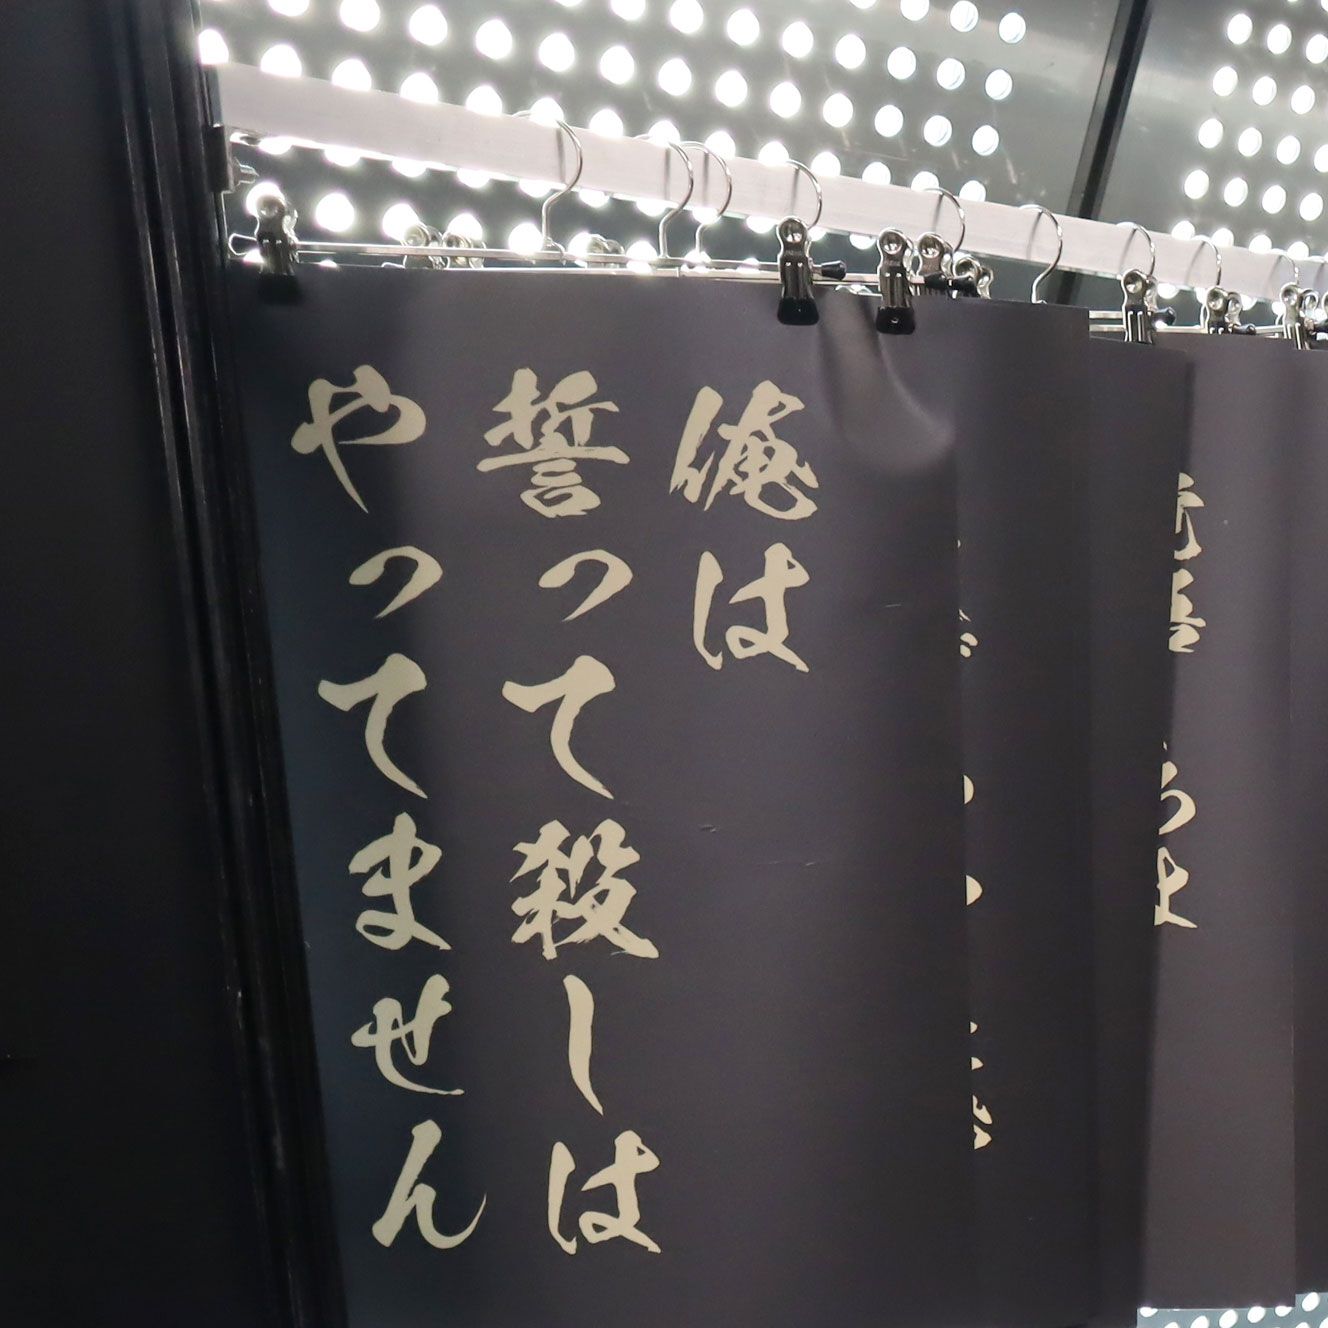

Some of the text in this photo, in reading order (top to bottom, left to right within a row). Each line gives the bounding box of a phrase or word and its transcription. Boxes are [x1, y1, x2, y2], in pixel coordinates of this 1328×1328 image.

[290, 364, 486, 1249] やってません
[477, 366, 662, 1255] 誓って殺しは
[669, 380, 818, 672] 俺は
